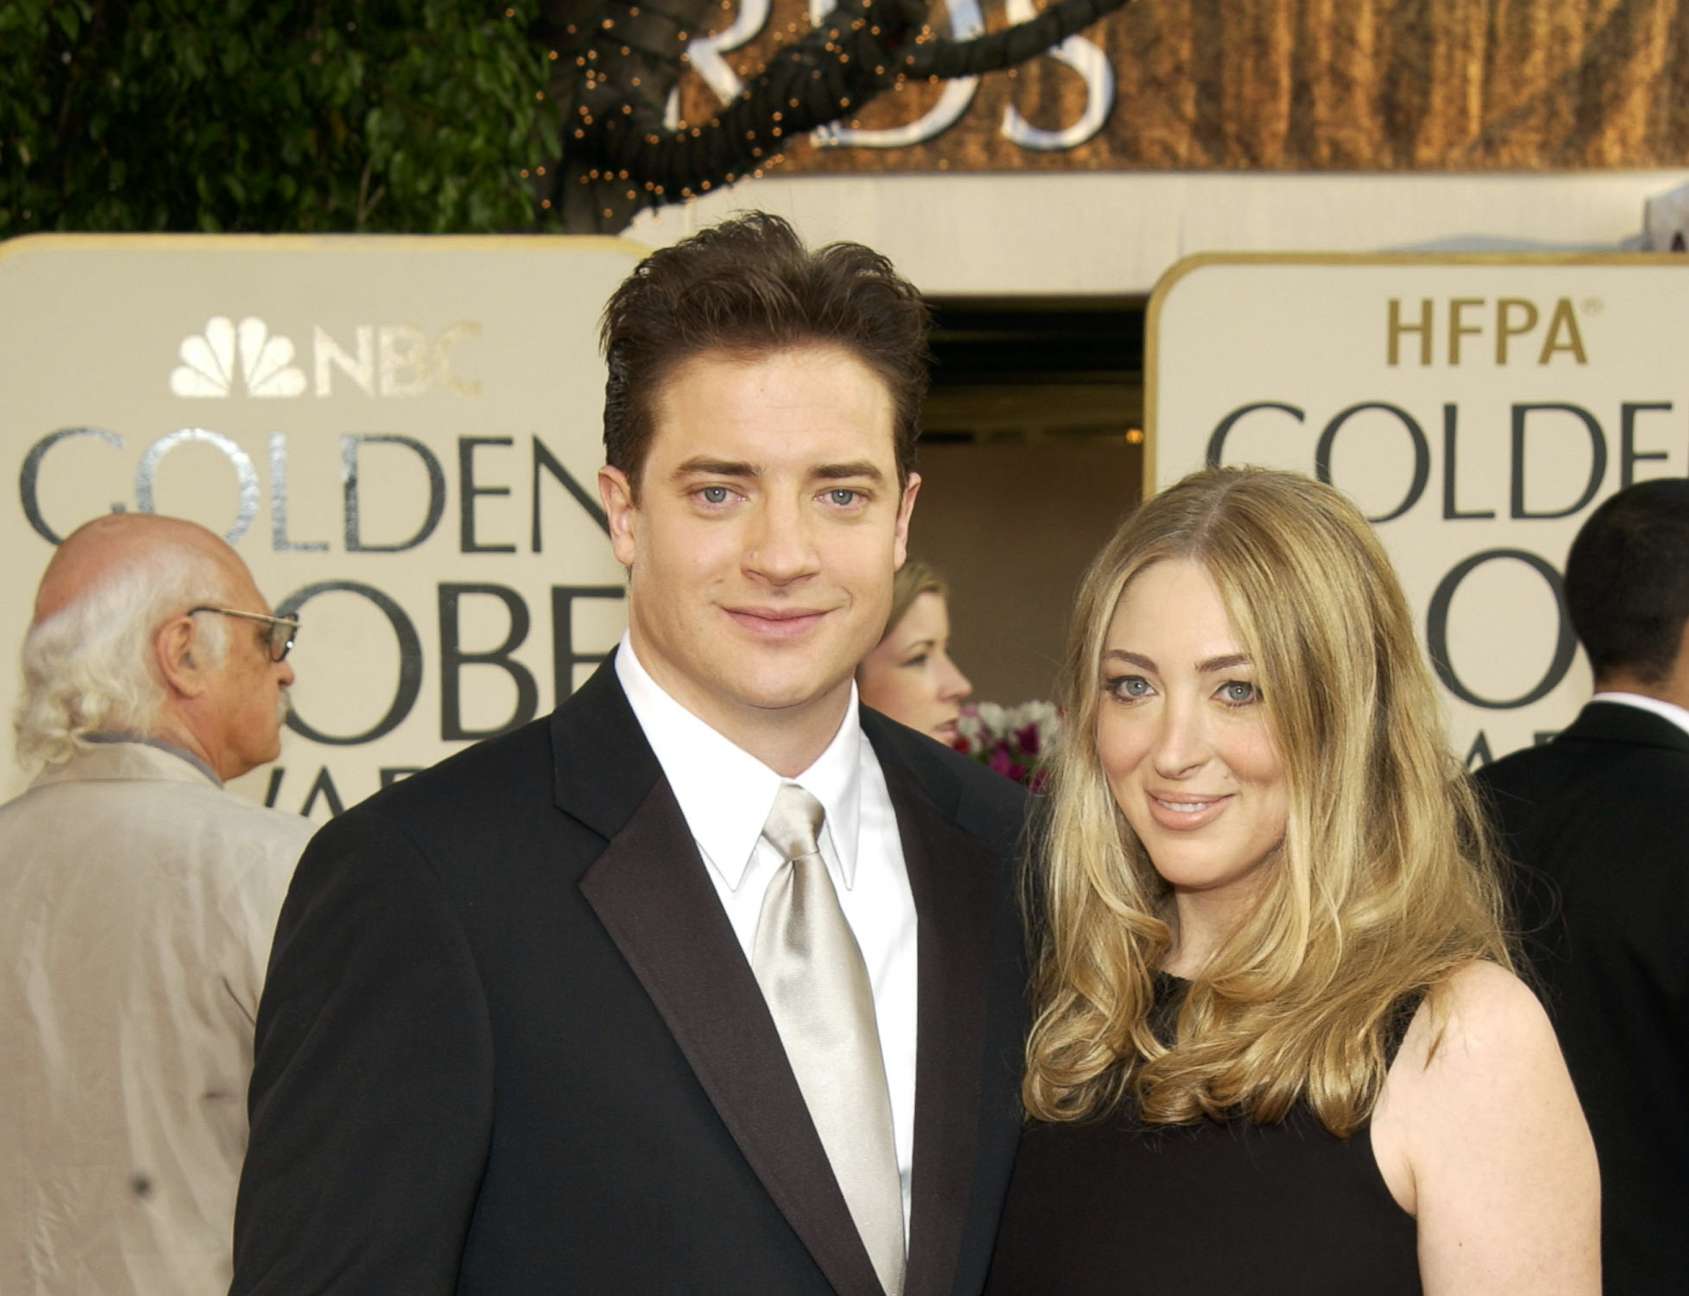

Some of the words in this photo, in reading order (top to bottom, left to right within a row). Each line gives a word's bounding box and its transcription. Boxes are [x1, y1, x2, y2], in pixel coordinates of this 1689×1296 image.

[313, 321, 483, 398] NBC
[19, 427, 612, 554] GOLDEN
[1205, 401, 1689, 524] GOLDE
[275, 580, 627, 748] OBE
